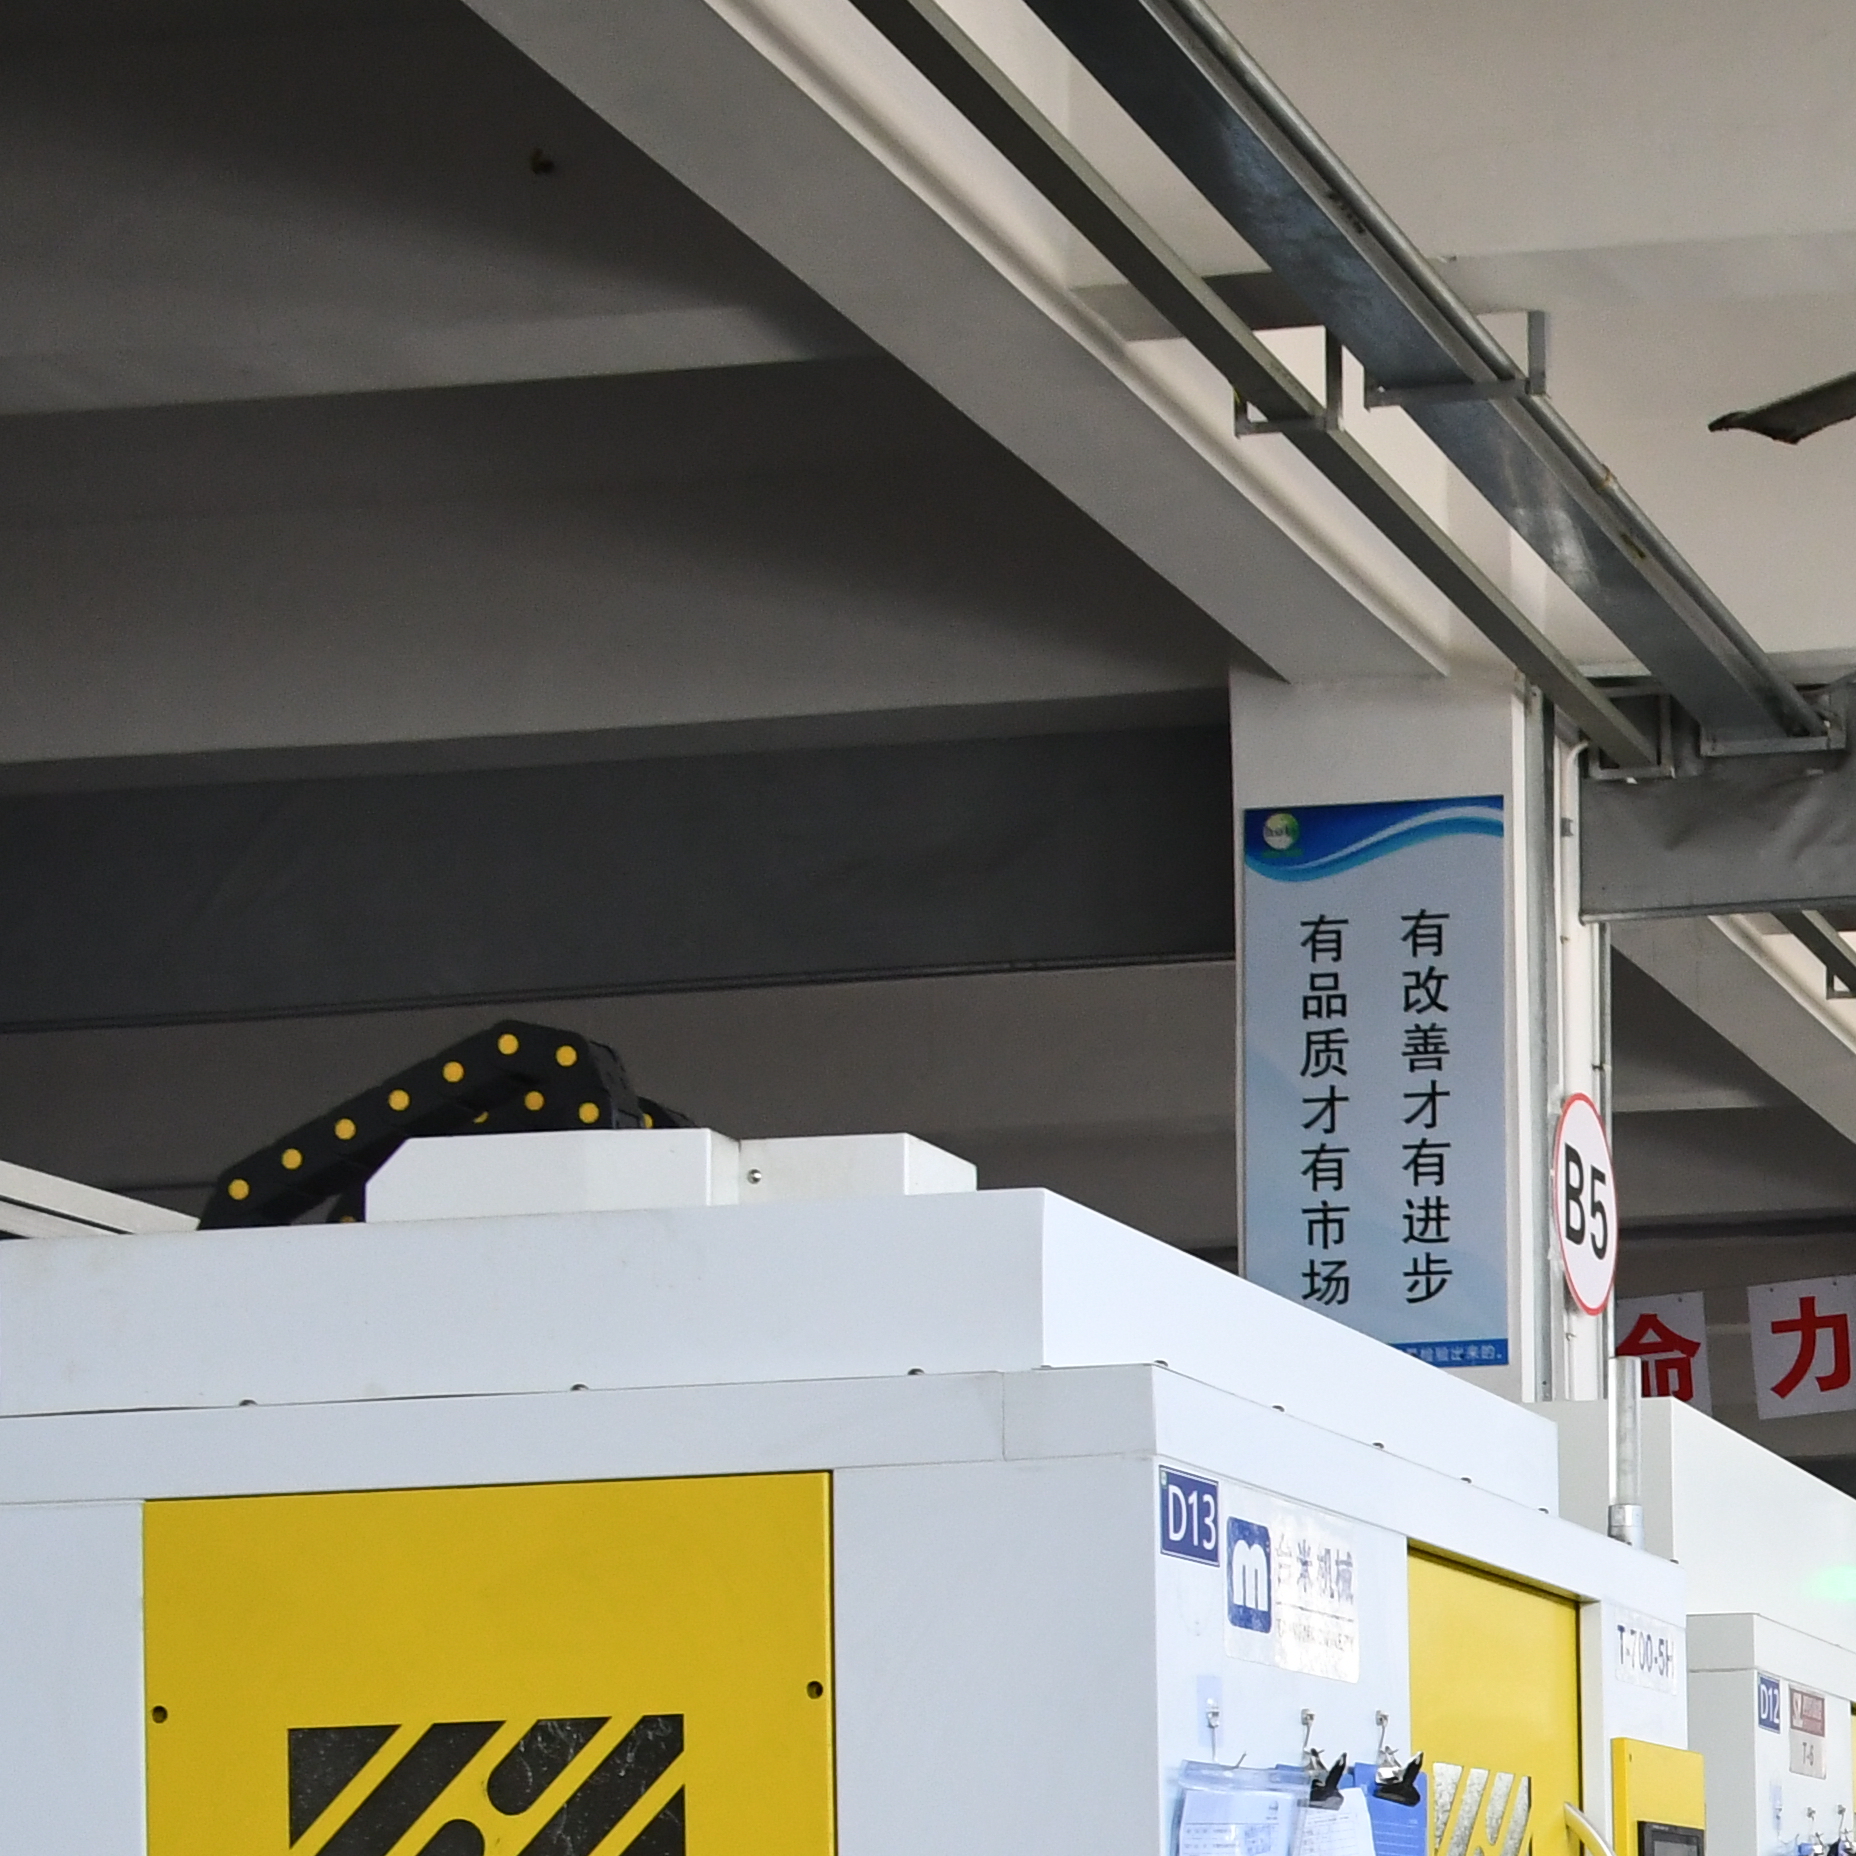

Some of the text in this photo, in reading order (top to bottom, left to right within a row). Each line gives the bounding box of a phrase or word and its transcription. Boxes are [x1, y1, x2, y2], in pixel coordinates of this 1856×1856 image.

[1300, 912, 1351, 1306] 有品质才有市场
[1400, 908, 1453, 1305] 有改善才有进步
[1564, 1141, 1609, 1261] B5
[1167, 1483, 1216, 1551] D13
[1760, 1683, 1780, 1724] D12
